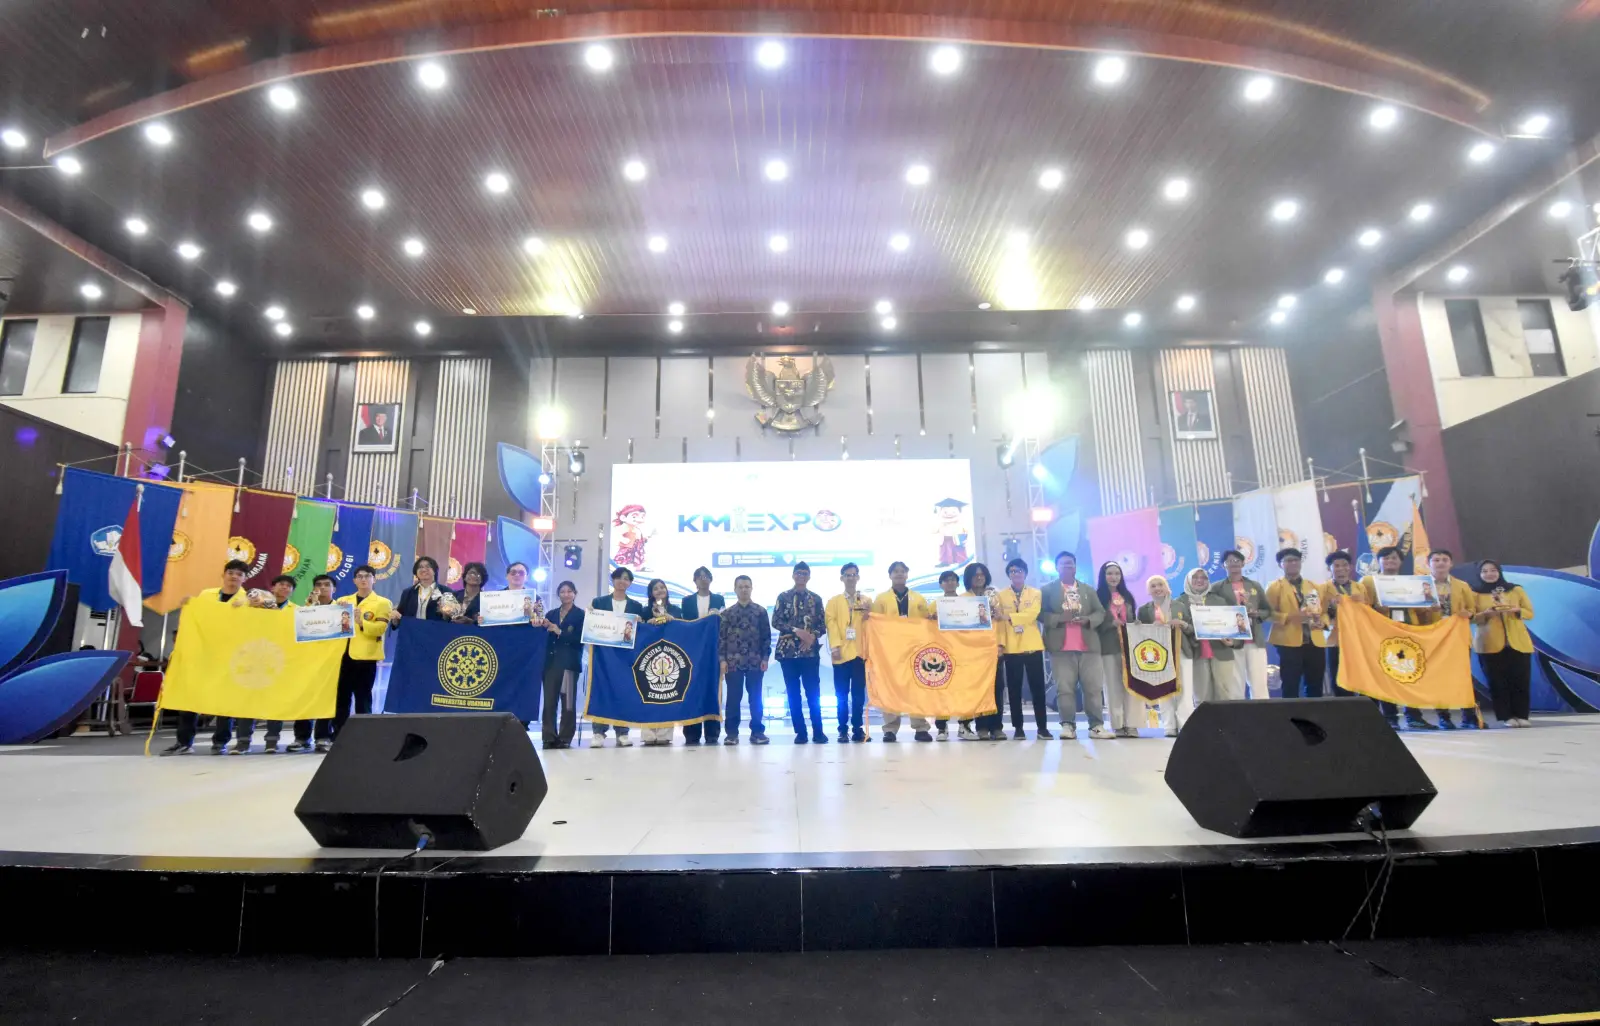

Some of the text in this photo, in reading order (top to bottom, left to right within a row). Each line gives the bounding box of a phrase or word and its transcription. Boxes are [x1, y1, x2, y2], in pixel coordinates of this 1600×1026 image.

[295, 558, 311, 581] TANIAN
[335, 555, 354, 581] IOLOGI
[1208, 551, 1221, 575] EKNIK
[639, 646, 686, 672] UNIVERSITAS DIPONEGORO
[433, 696, 491, 708] UNIVERSITAS UDAYANA
[647, 690, 679, 700] SEMARANG
